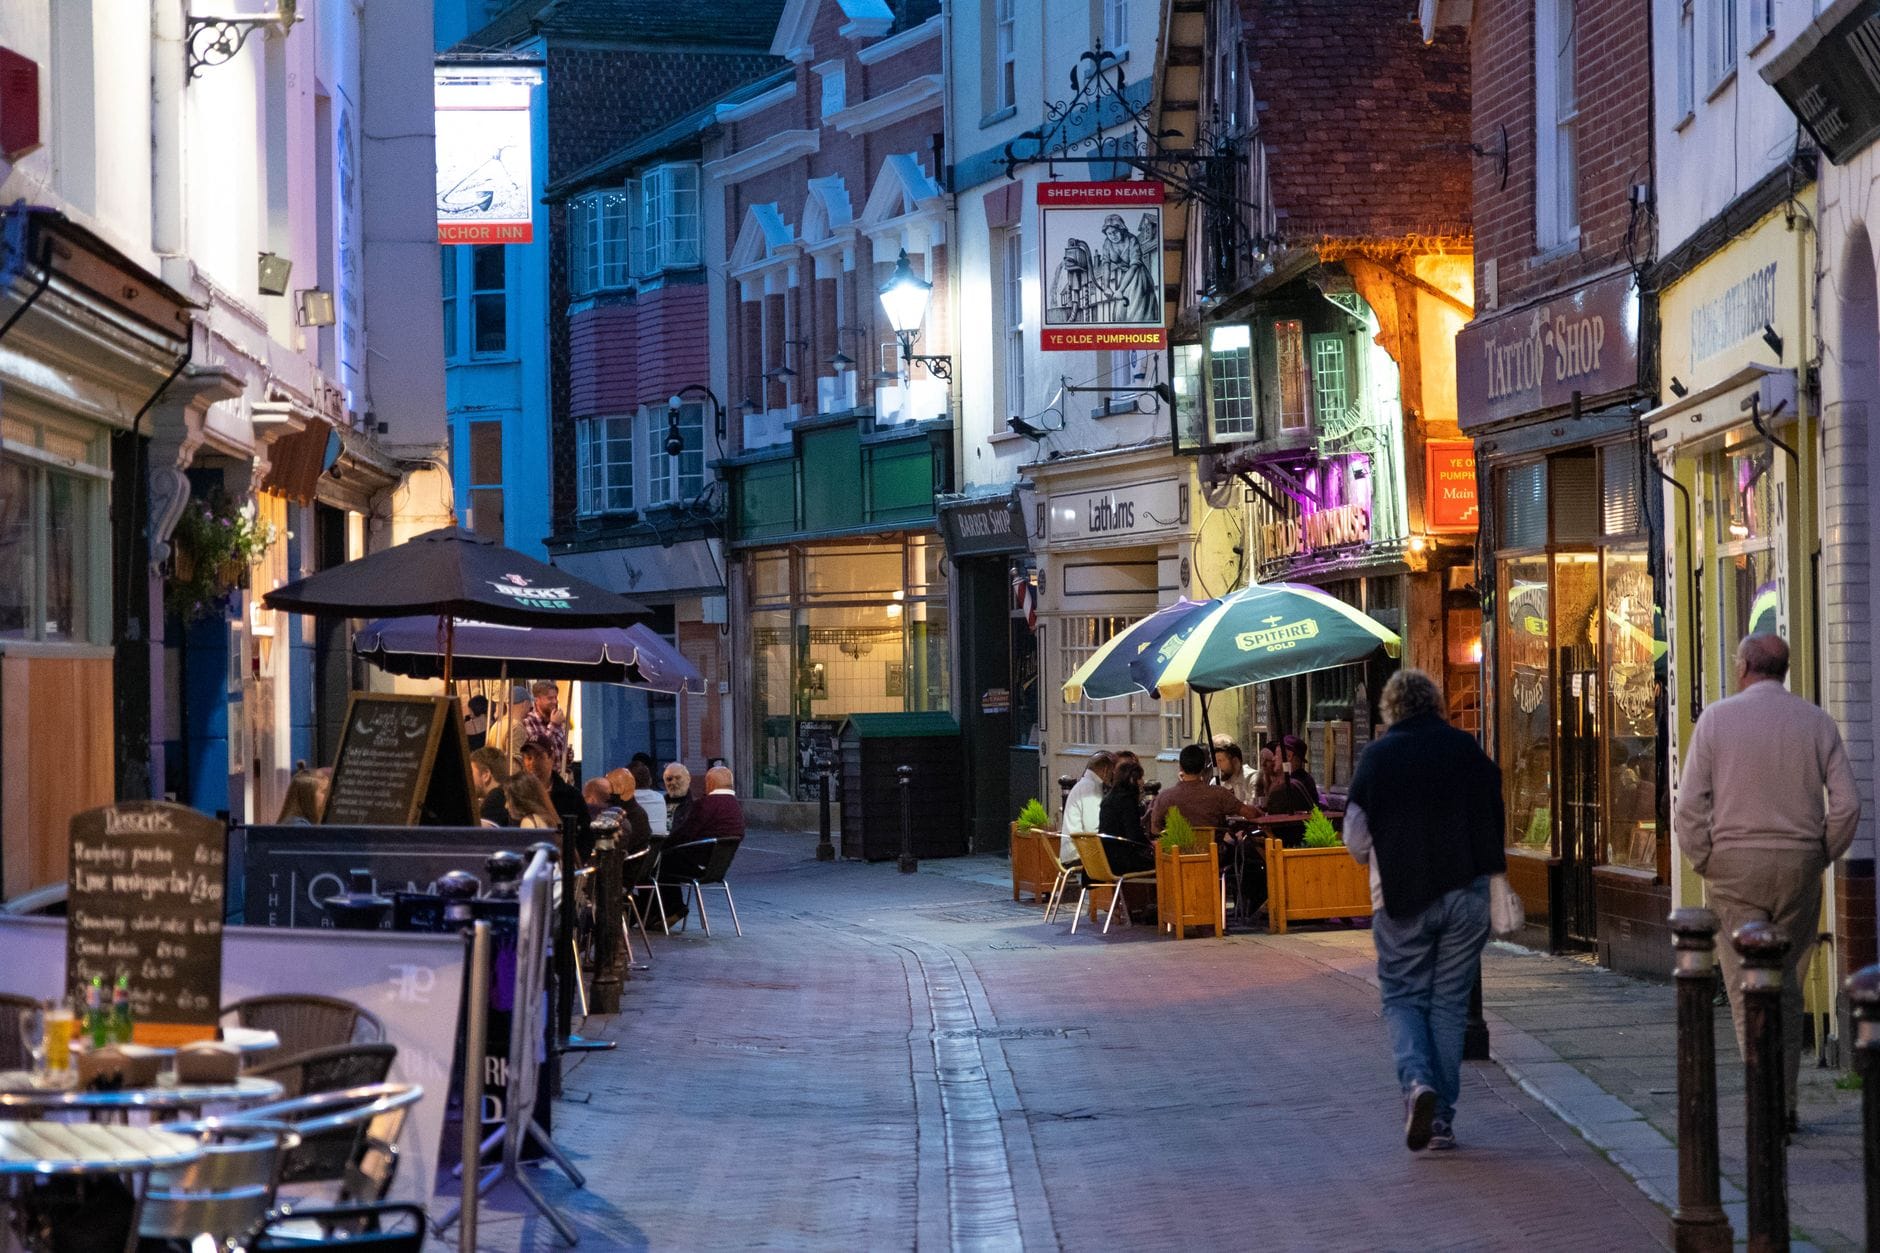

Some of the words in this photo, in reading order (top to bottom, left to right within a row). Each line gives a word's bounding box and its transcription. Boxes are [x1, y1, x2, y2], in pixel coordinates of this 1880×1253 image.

[1048, 188, 1112, 197] SHEPHERD
[1115, 188, 1156, 197] NEAME
[437, 227, 490, 239] NCHOR
[496, 226, 523, 238] INN
[1050, 335, 1063, 344] YE
[1066, 334, 1093, 344] OLDE
[1096, 333, 1160, 344] PUMPHOUSE
[1484, 335, 1545, 400] TATTOO
[1555, 314, 1605, 382] SHOP
[1450, 459, 1463, 467] YE
[1440, 471, 1475, 480] PUMPH
[1443, 487, 1474, 499] Main
[1089, 495, 1134, 532] Lathams
[958, 512, 991, 538] BARBER
[989, 509, 1011, 534] SHOP
[514, 597, 571, 609] VIER
[1243, 623, 1311, 647] SPITFIRE
[1266, 641, 1296, 652] GOLD
[1520, 675, 1543, 714] LADIES
